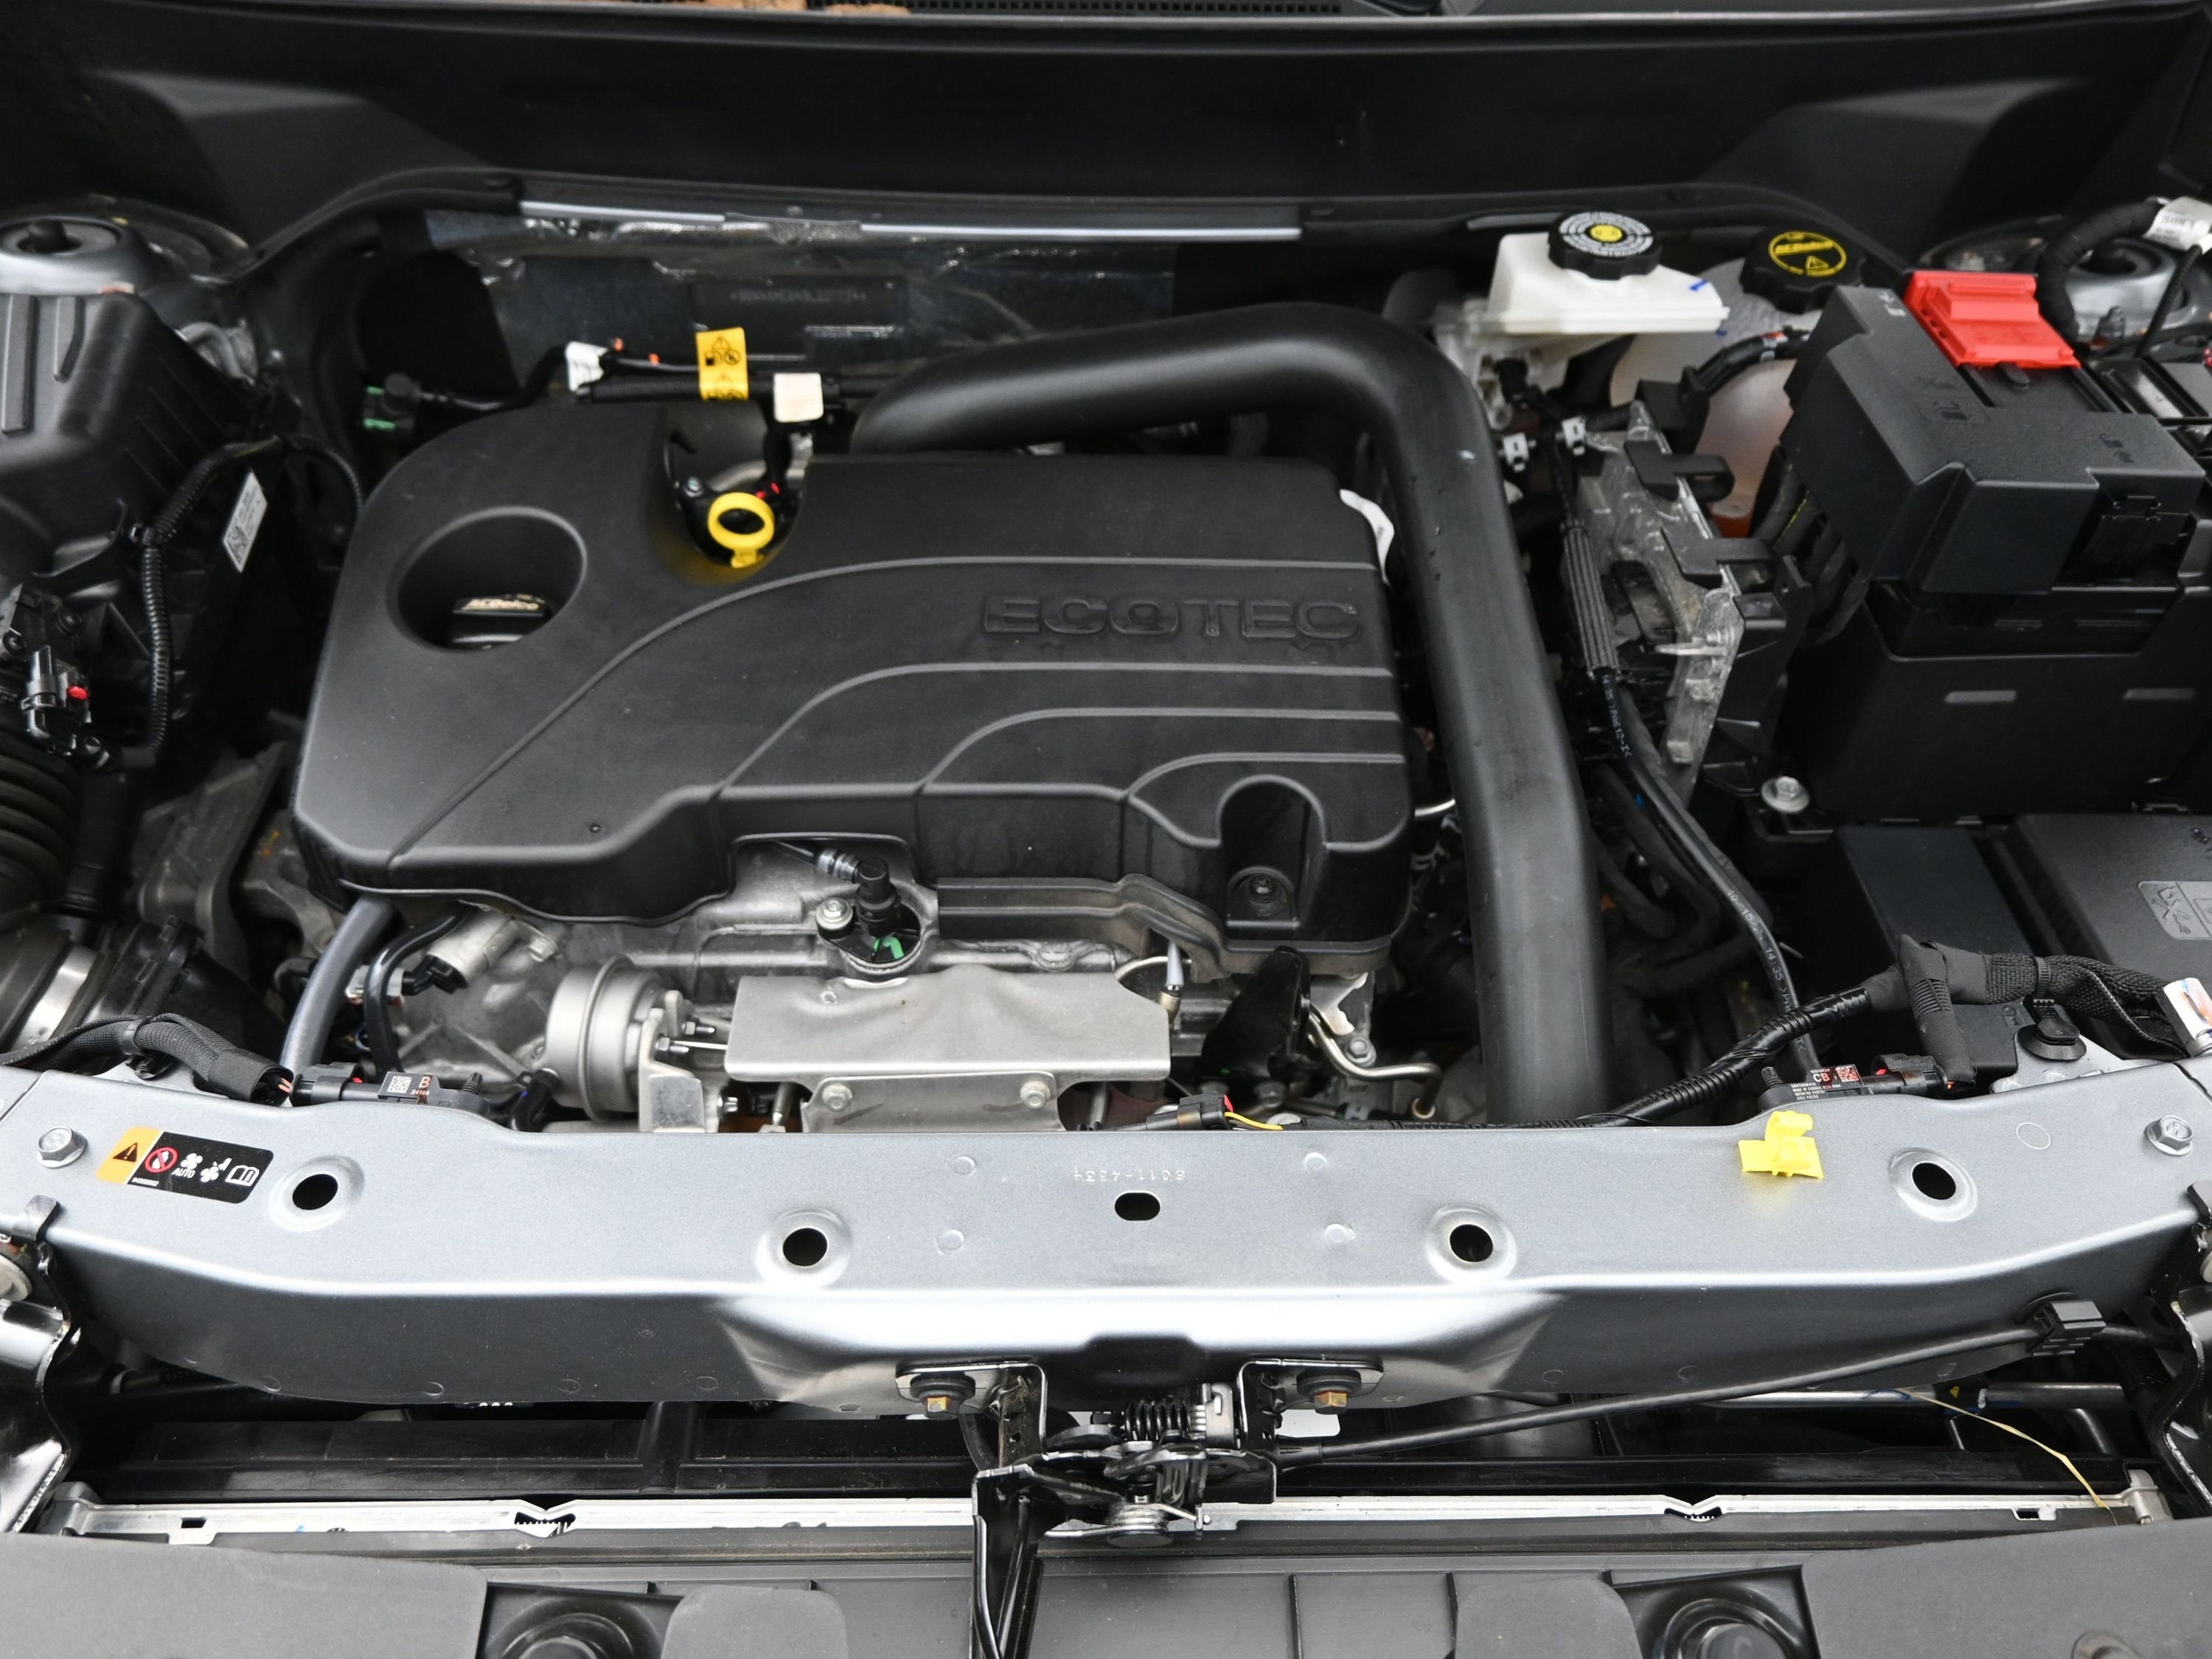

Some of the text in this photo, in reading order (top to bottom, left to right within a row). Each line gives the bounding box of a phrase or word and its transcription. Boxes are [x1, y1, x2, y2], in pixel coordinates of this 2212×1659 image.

[985, 597, 1358, 639] ECOTEC
[1765, 947, 1784, 981] 14:35
[418, 1076, 431, 1088] B
[171, 1167, 195, 1178] AUTO
